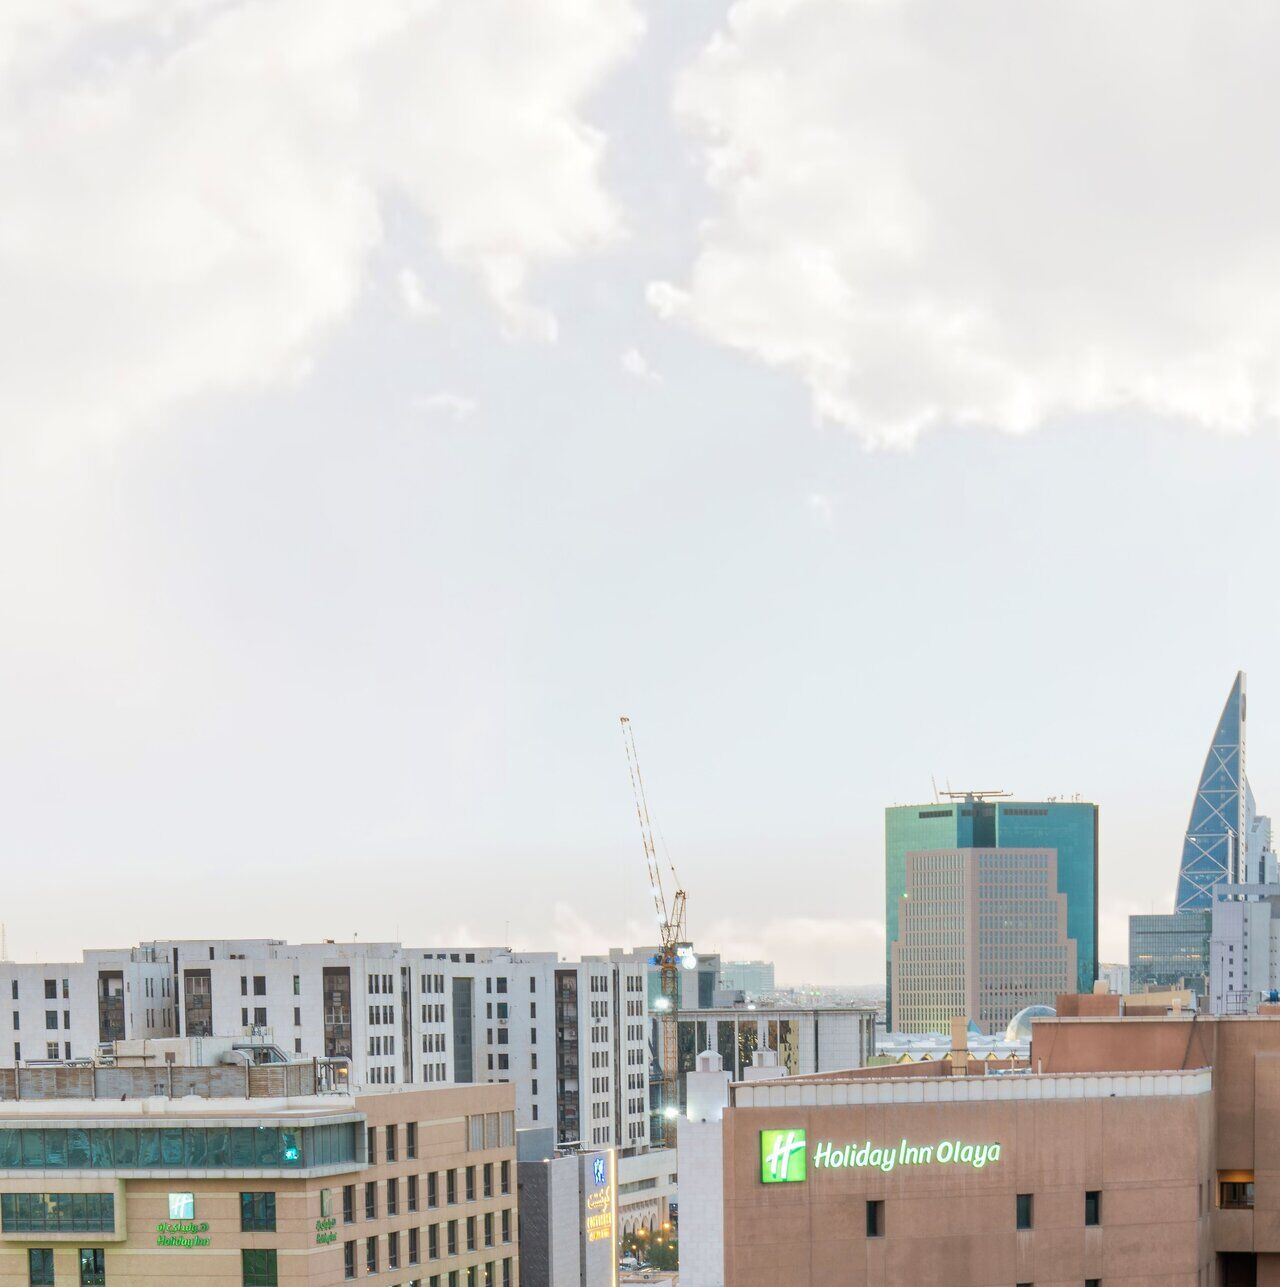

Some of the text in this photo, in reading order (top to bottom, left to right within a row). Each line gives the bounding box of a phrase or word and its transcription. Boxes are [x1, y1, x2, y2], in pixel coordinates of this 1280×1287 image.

[814, 1139, 1001, 1172] Holiday Inn Olaya
[157, 1235, 210, 1247] Holiday Inn
